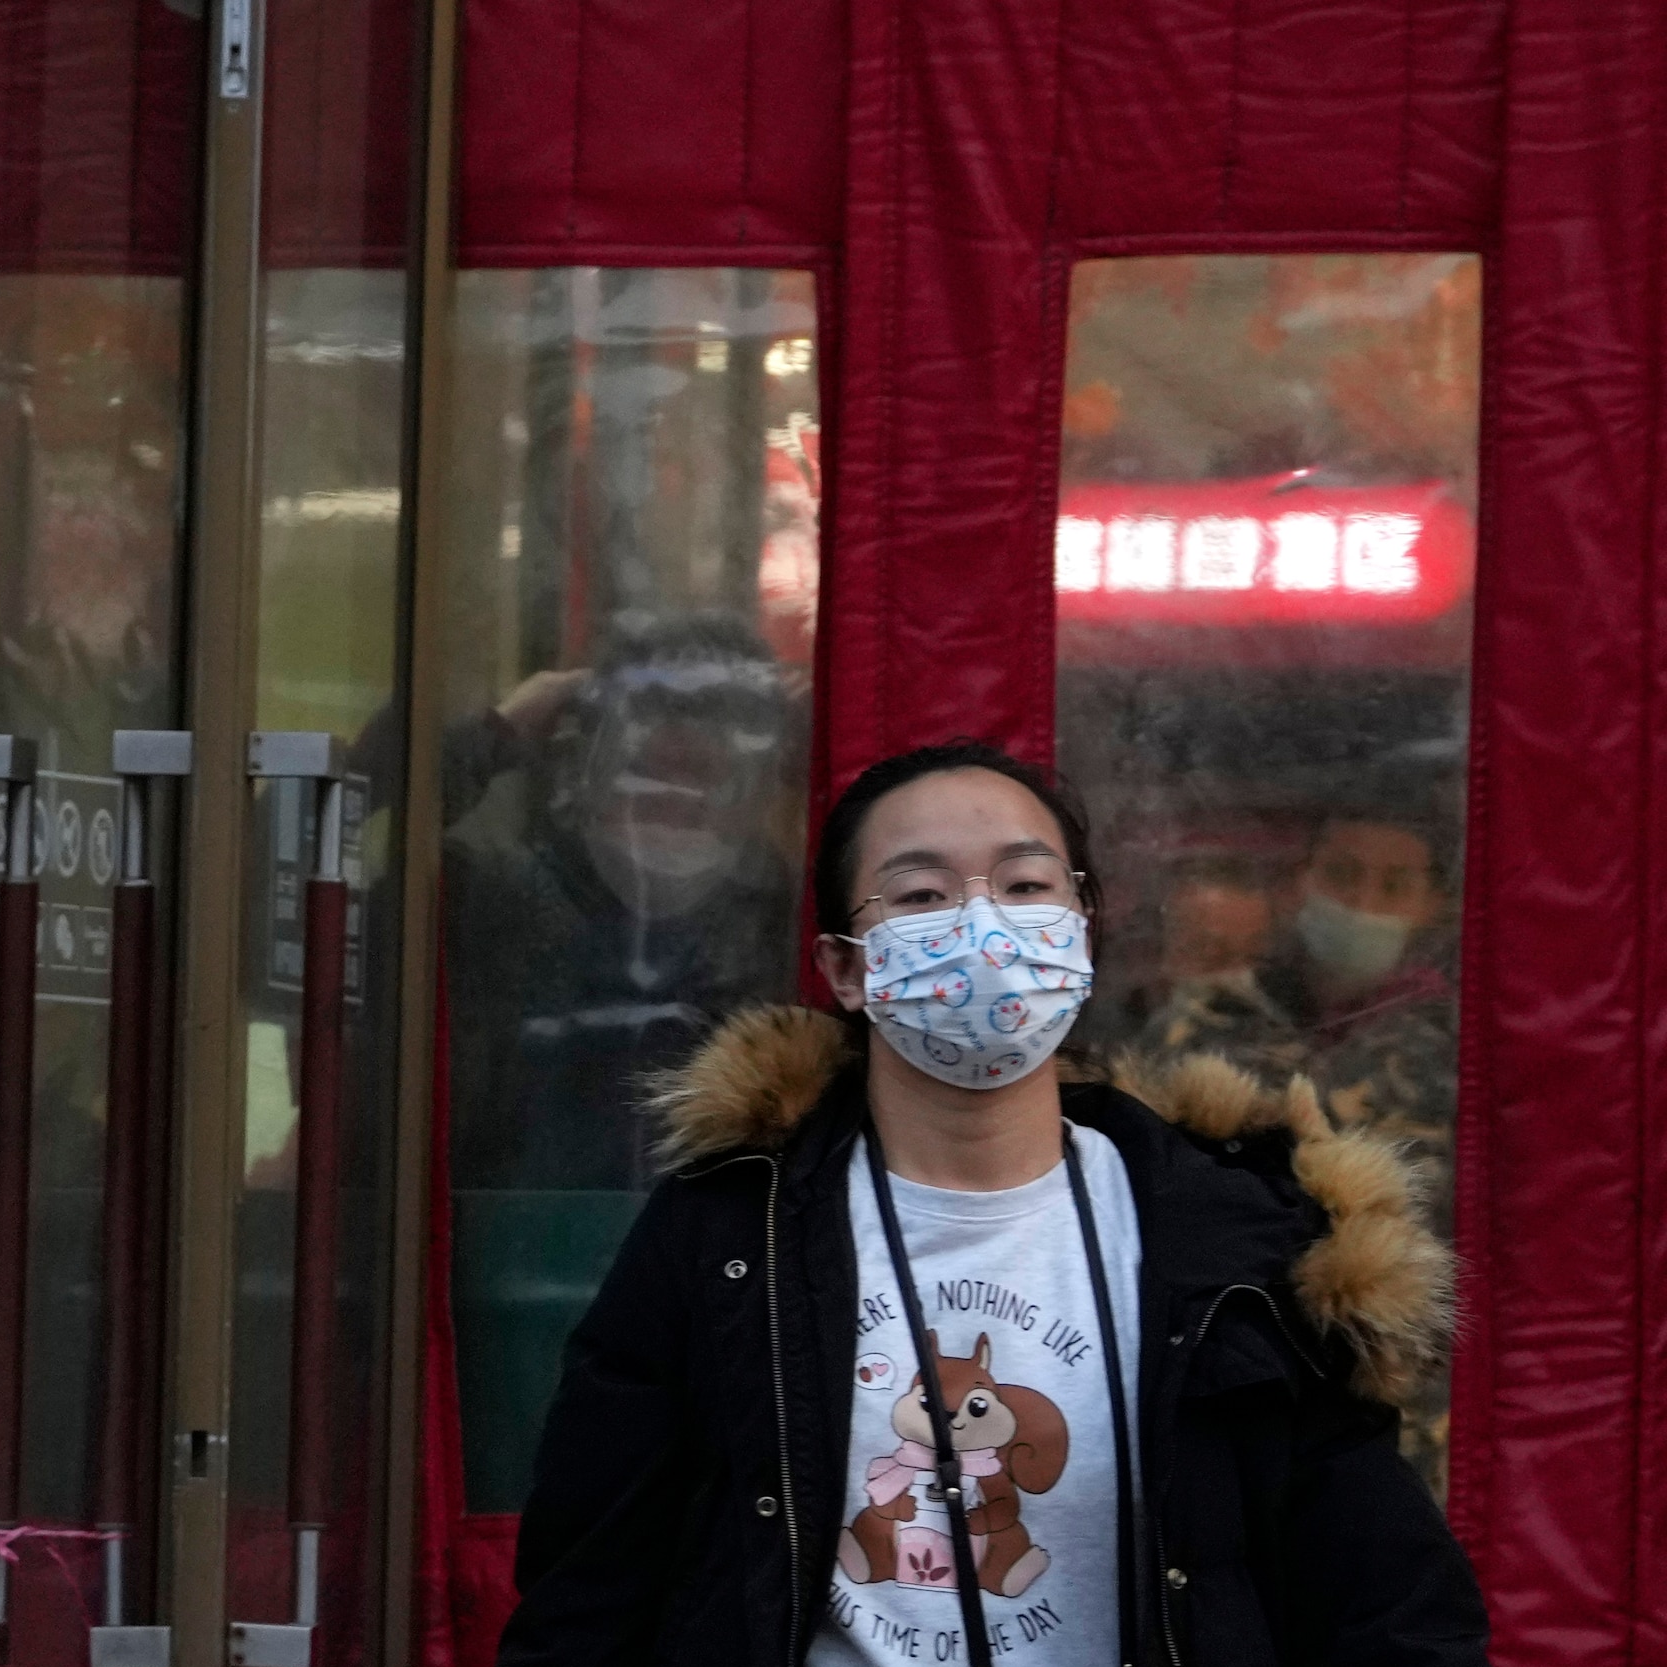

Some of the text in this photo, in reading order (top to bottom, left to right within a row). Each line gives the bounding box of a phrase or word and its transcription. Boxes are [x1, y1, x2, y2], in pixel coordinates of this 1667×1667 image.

[856, 1279, 1093, 1367] ERE NOTHING LIKE
[829, 1582, 1063, 1662] HIS TIME OF HE DAY
